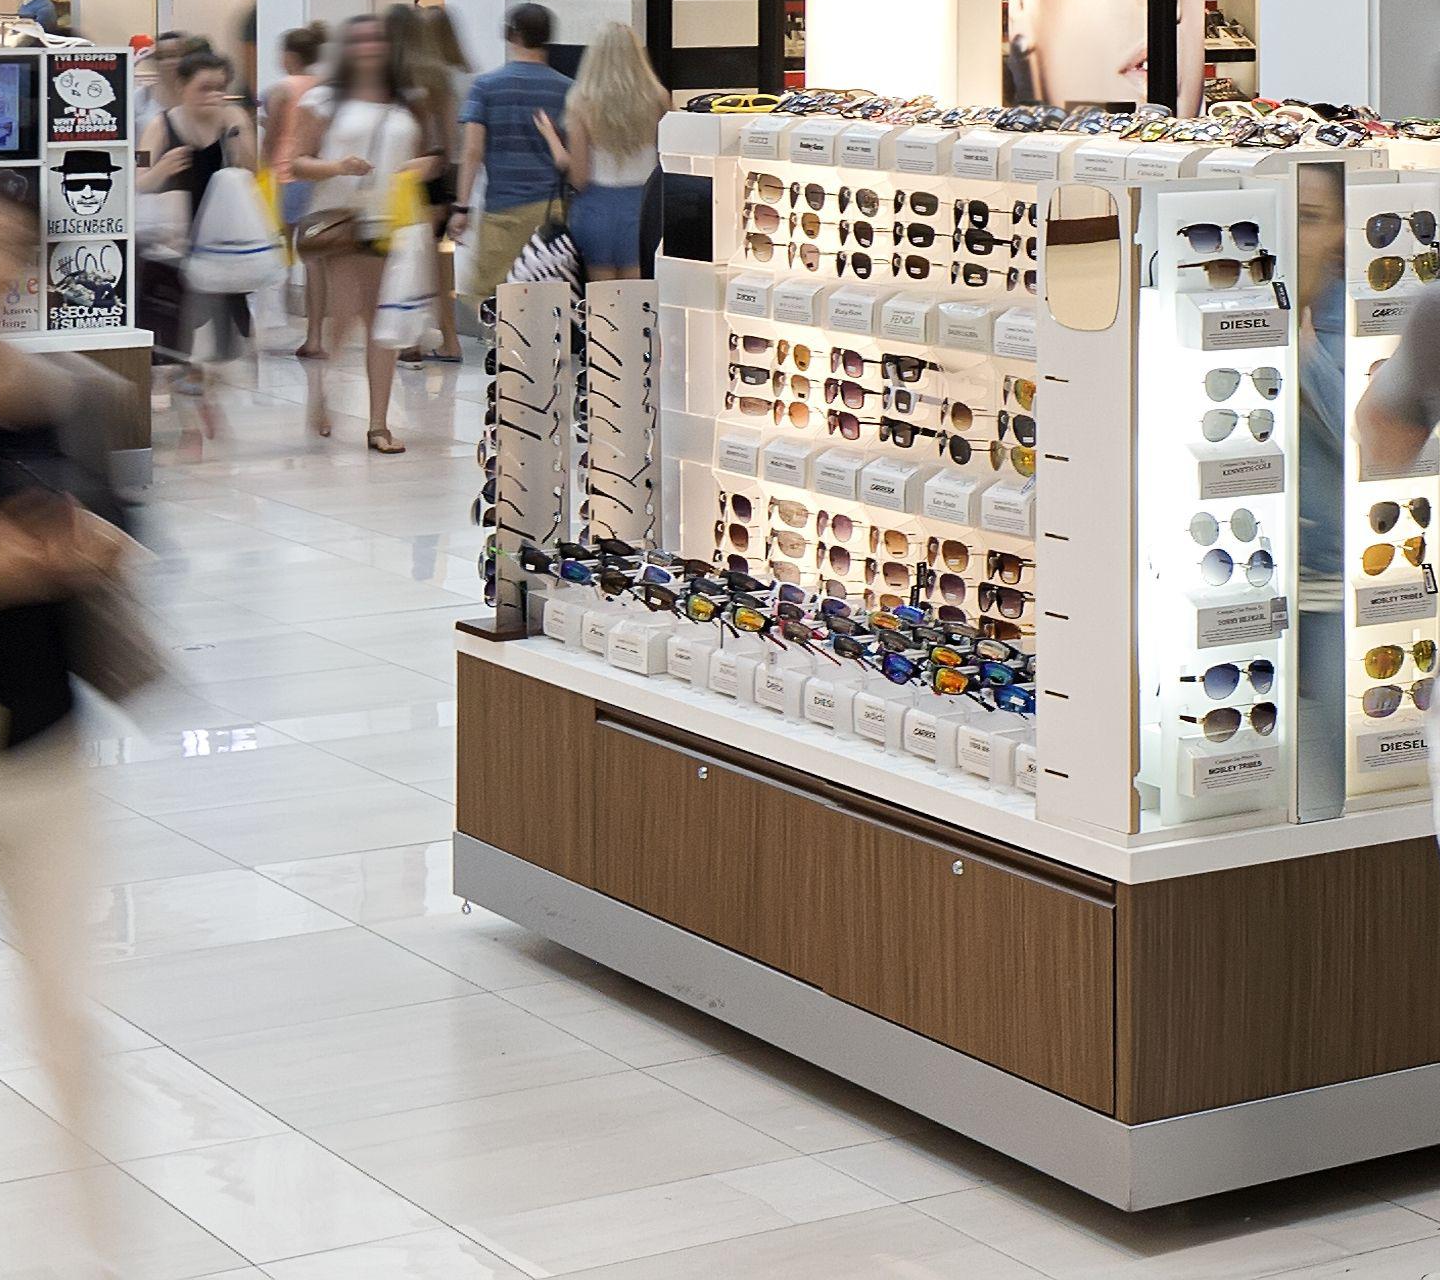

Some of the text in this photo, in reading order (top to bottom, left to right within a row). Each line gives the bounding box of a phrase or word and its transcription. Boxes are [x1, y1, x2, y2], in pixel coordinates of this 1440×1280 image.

[47, 218, 124, 234] HEISENBERG
[1220, 318, 1270, 330] DIESEL
[1380, 739, 1428, 752] DIESEL
[1208, 760, 1263, 775] MOSLEY TRIBES
